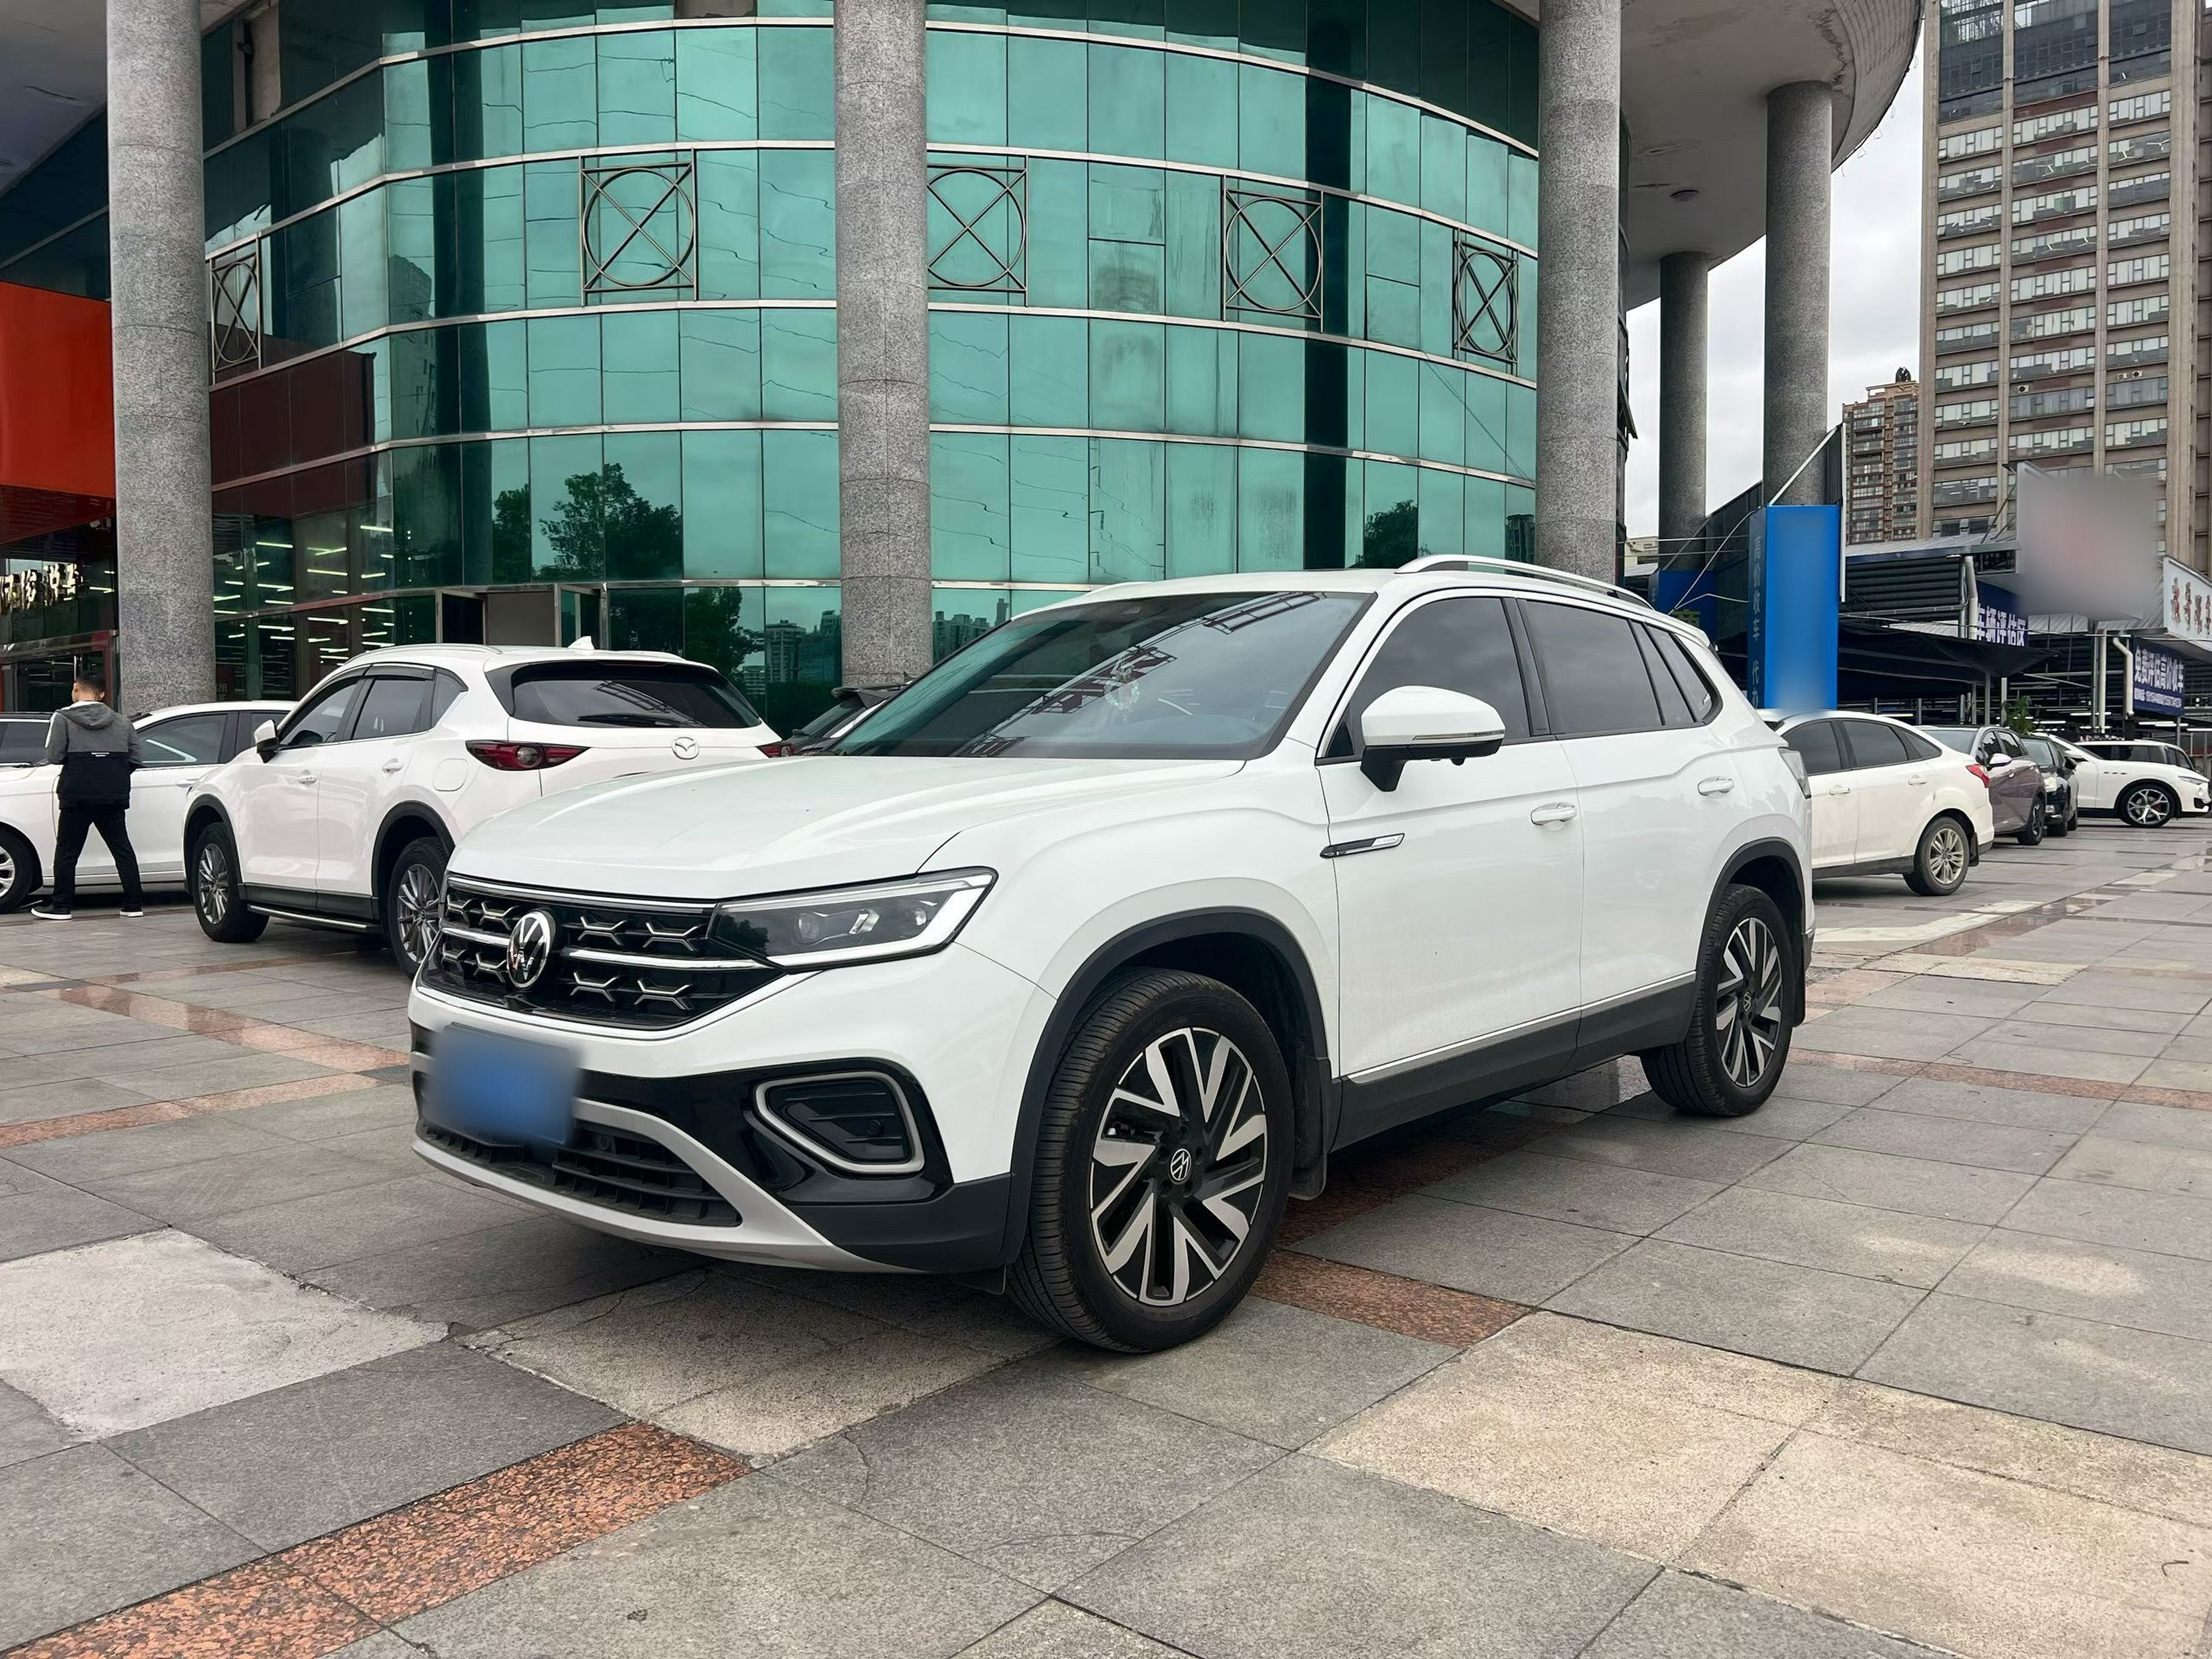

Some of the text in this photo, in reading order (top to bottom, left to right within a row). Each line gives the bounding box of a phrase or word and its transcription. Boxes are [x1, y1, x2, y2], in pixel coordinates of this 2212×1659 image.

[1977, 603, 2026, 646] 车辆评估区
